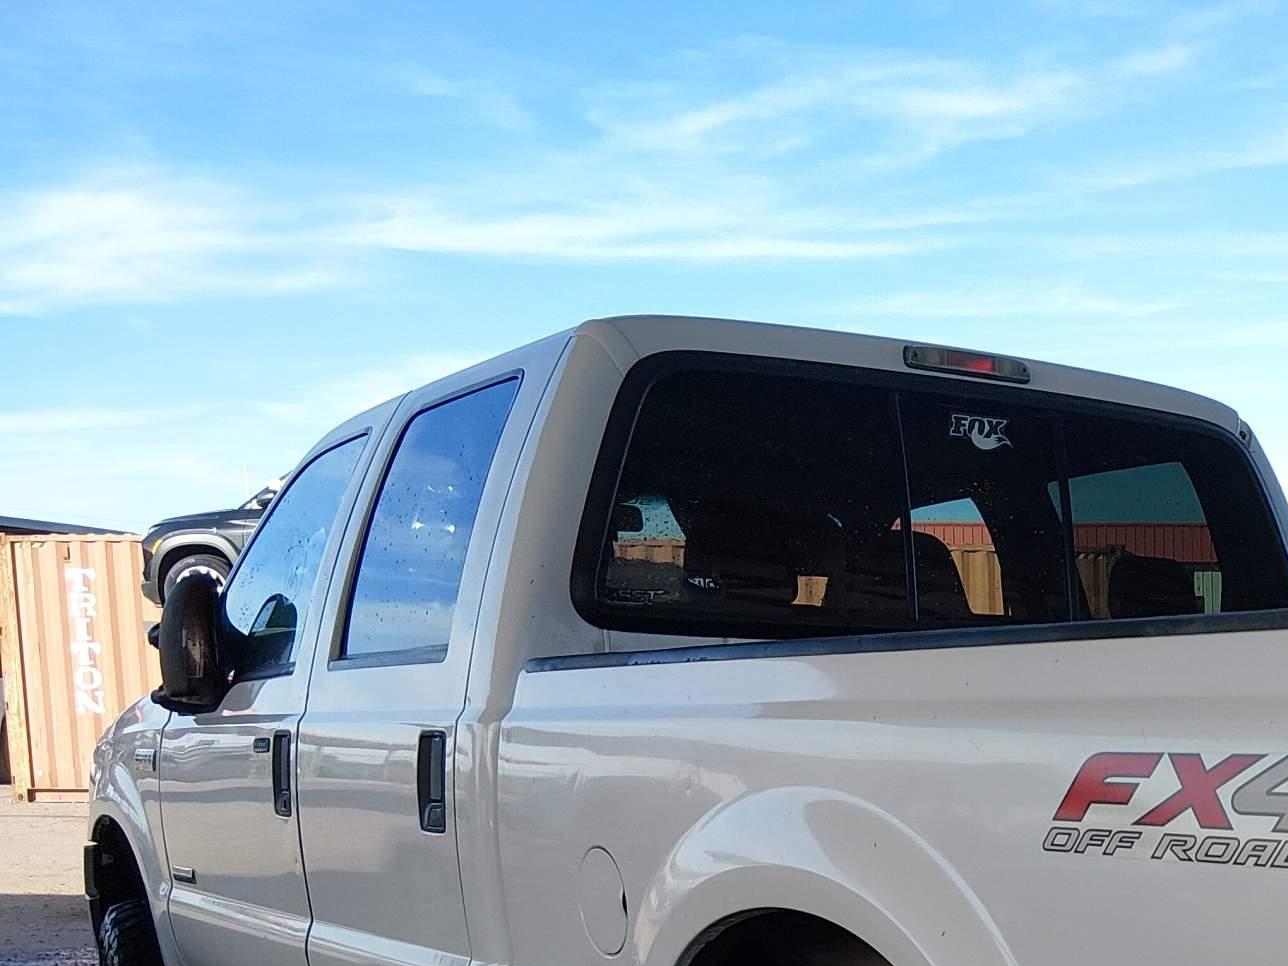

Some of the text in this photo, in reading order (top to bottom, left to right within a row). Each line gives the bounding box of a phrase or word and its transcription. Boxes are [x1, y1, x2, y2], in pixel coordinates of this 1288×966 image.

[950, 414, 1007, 438] FOX
[64, 567, 106, 715] TRITON
[1042, 827, 1143, 856] OFF
